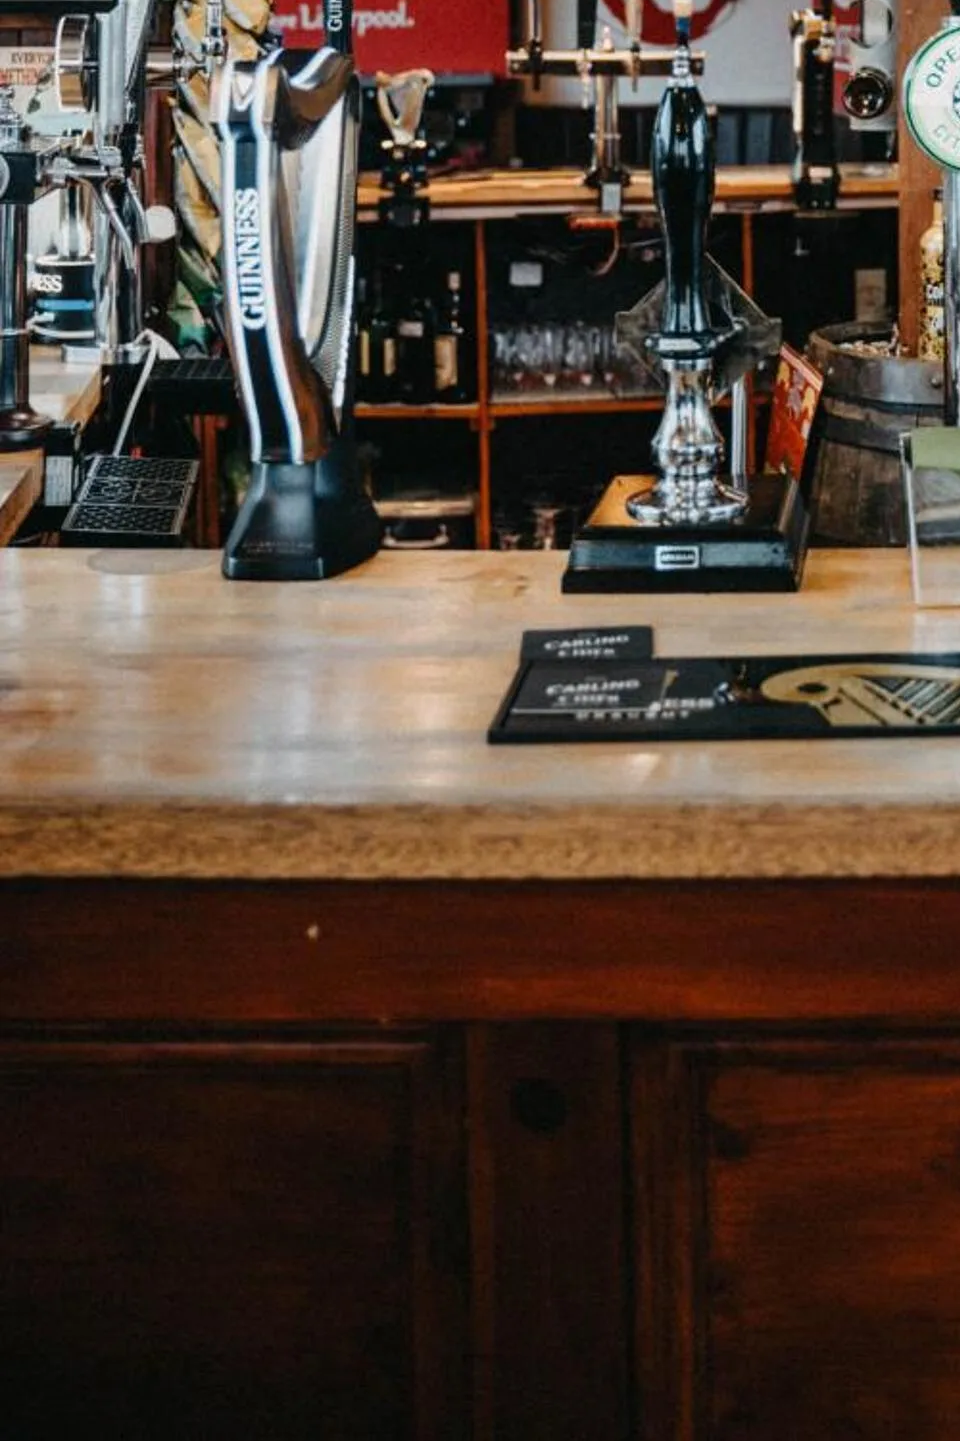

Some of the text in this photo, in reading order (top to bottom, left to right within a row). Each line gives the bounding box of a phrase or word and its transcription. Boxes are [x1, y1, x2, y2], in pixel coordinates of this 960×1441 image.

[236, 187, 267, 330] GUINNESS
[544, 634, 629, 651] CARLING
[545, 678, 641, 695] CARLING
